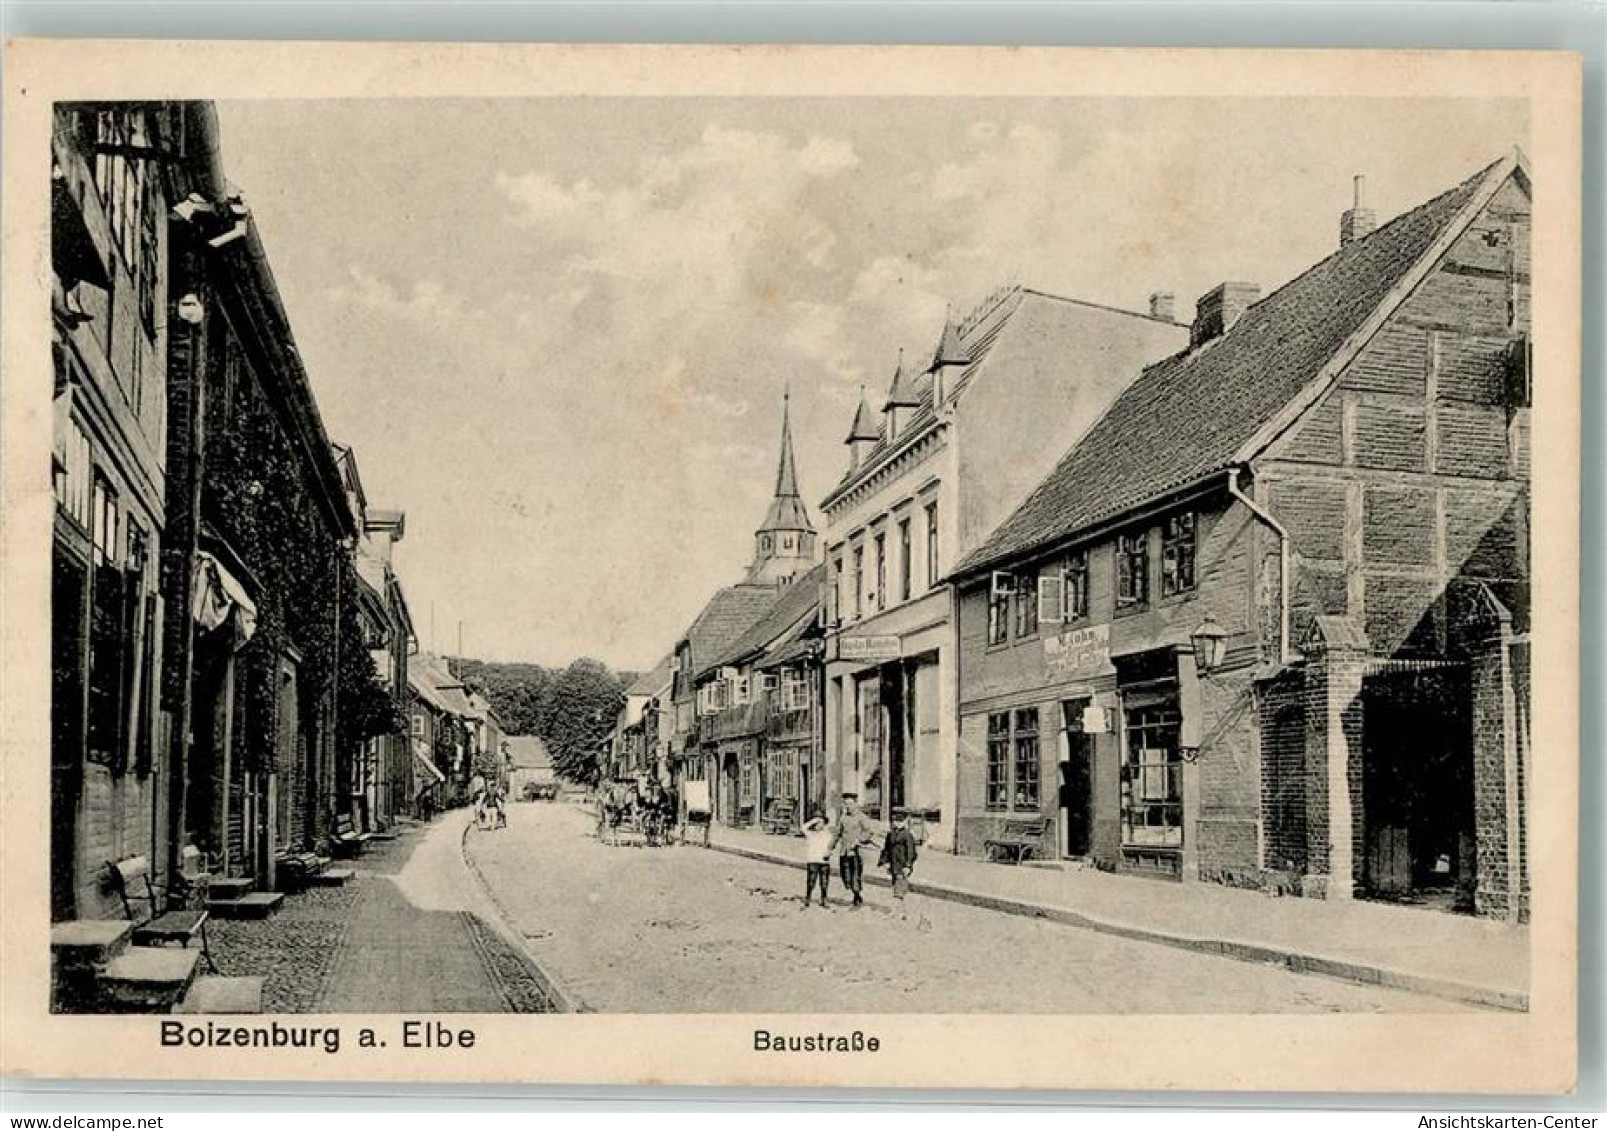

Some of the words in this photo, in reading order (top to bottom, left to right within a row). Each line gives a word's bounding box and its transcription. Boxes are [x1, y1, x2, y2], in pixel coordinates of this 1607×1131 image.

[162, 1020, 340, 1054] Boizenburg
[359, 1028, 387, 1048] a.
[403, 1020, 476, 1048] Elbe
[754, 1030, 880, 1052] Baustraße
